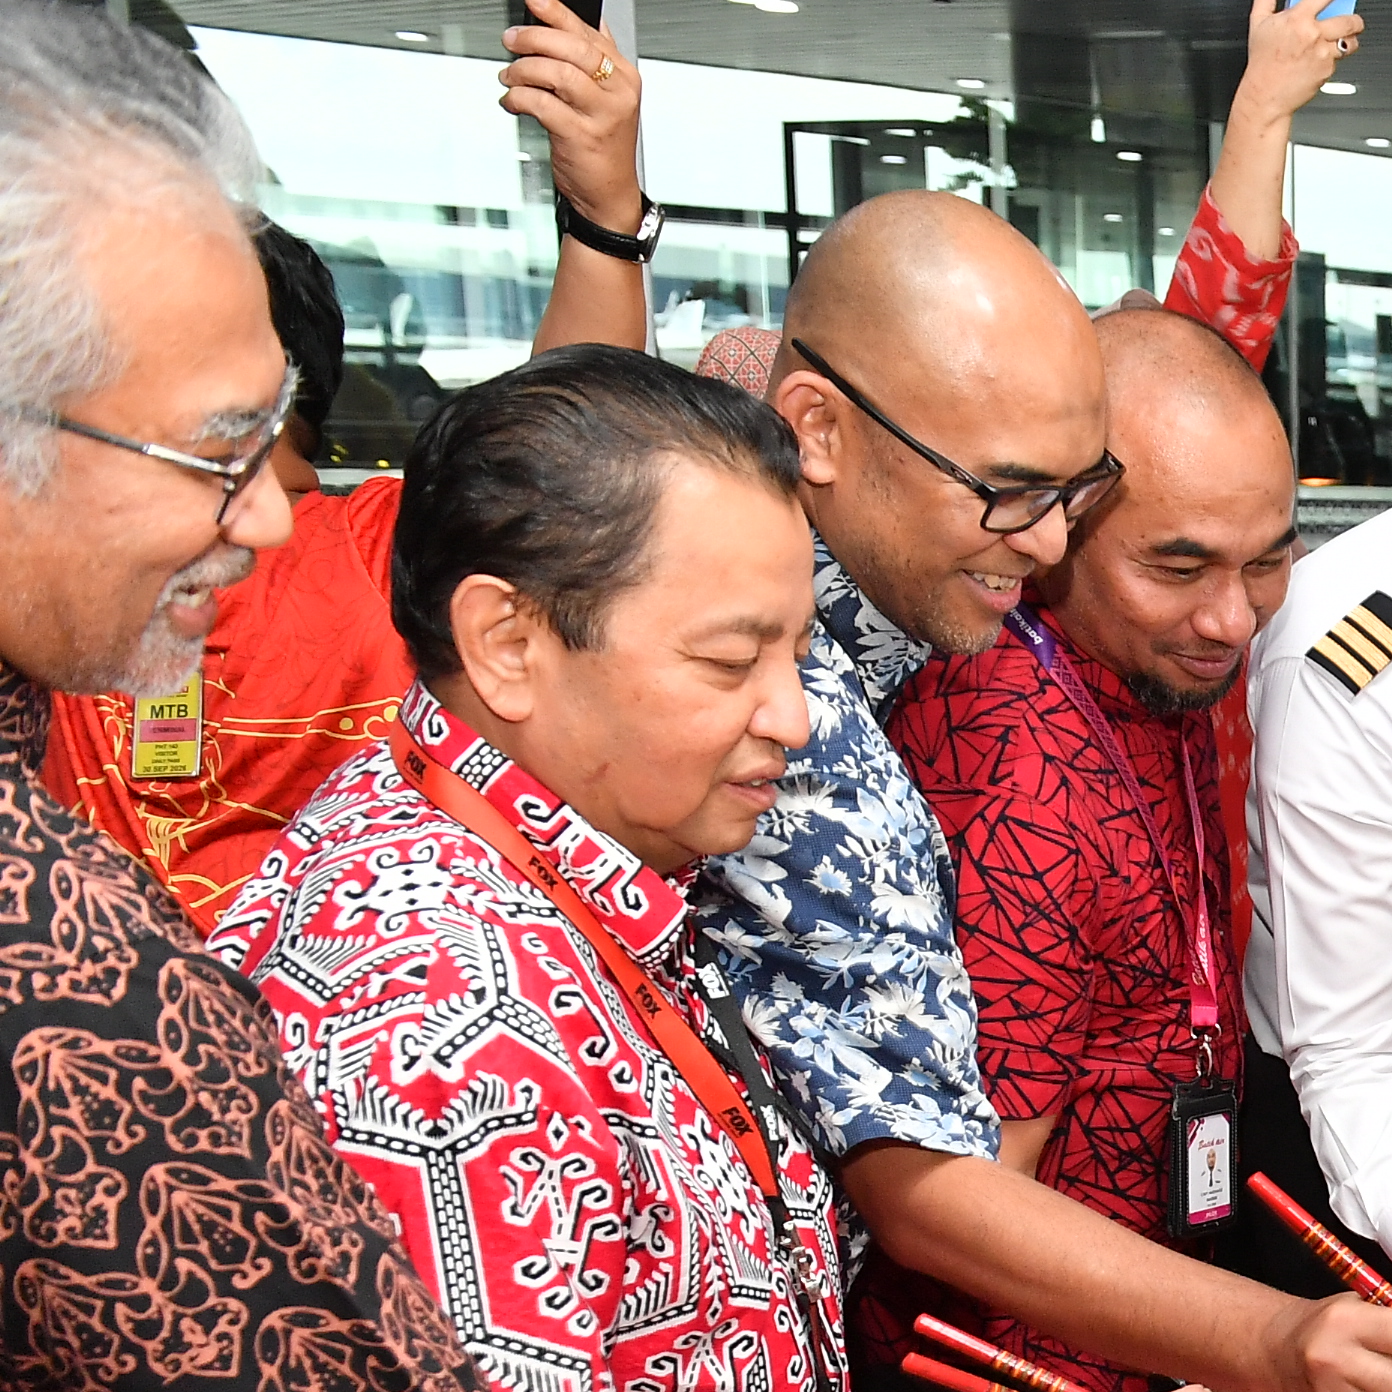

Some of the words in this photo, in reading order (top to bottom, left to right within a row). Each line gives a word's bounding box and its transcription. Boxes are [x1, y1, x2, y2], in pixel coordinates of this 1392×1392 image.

[150, 704, 188, 719] MTB
[404, 750, 427, 780] FOX
[528, 855, 559, 891] FOX
[695, 962, 727, 999] FOX
[635, 983, 662, 1020] FOX
[722, 1107, 754, 1138] FOX
[760, 1105, 779, 1141] FOX
